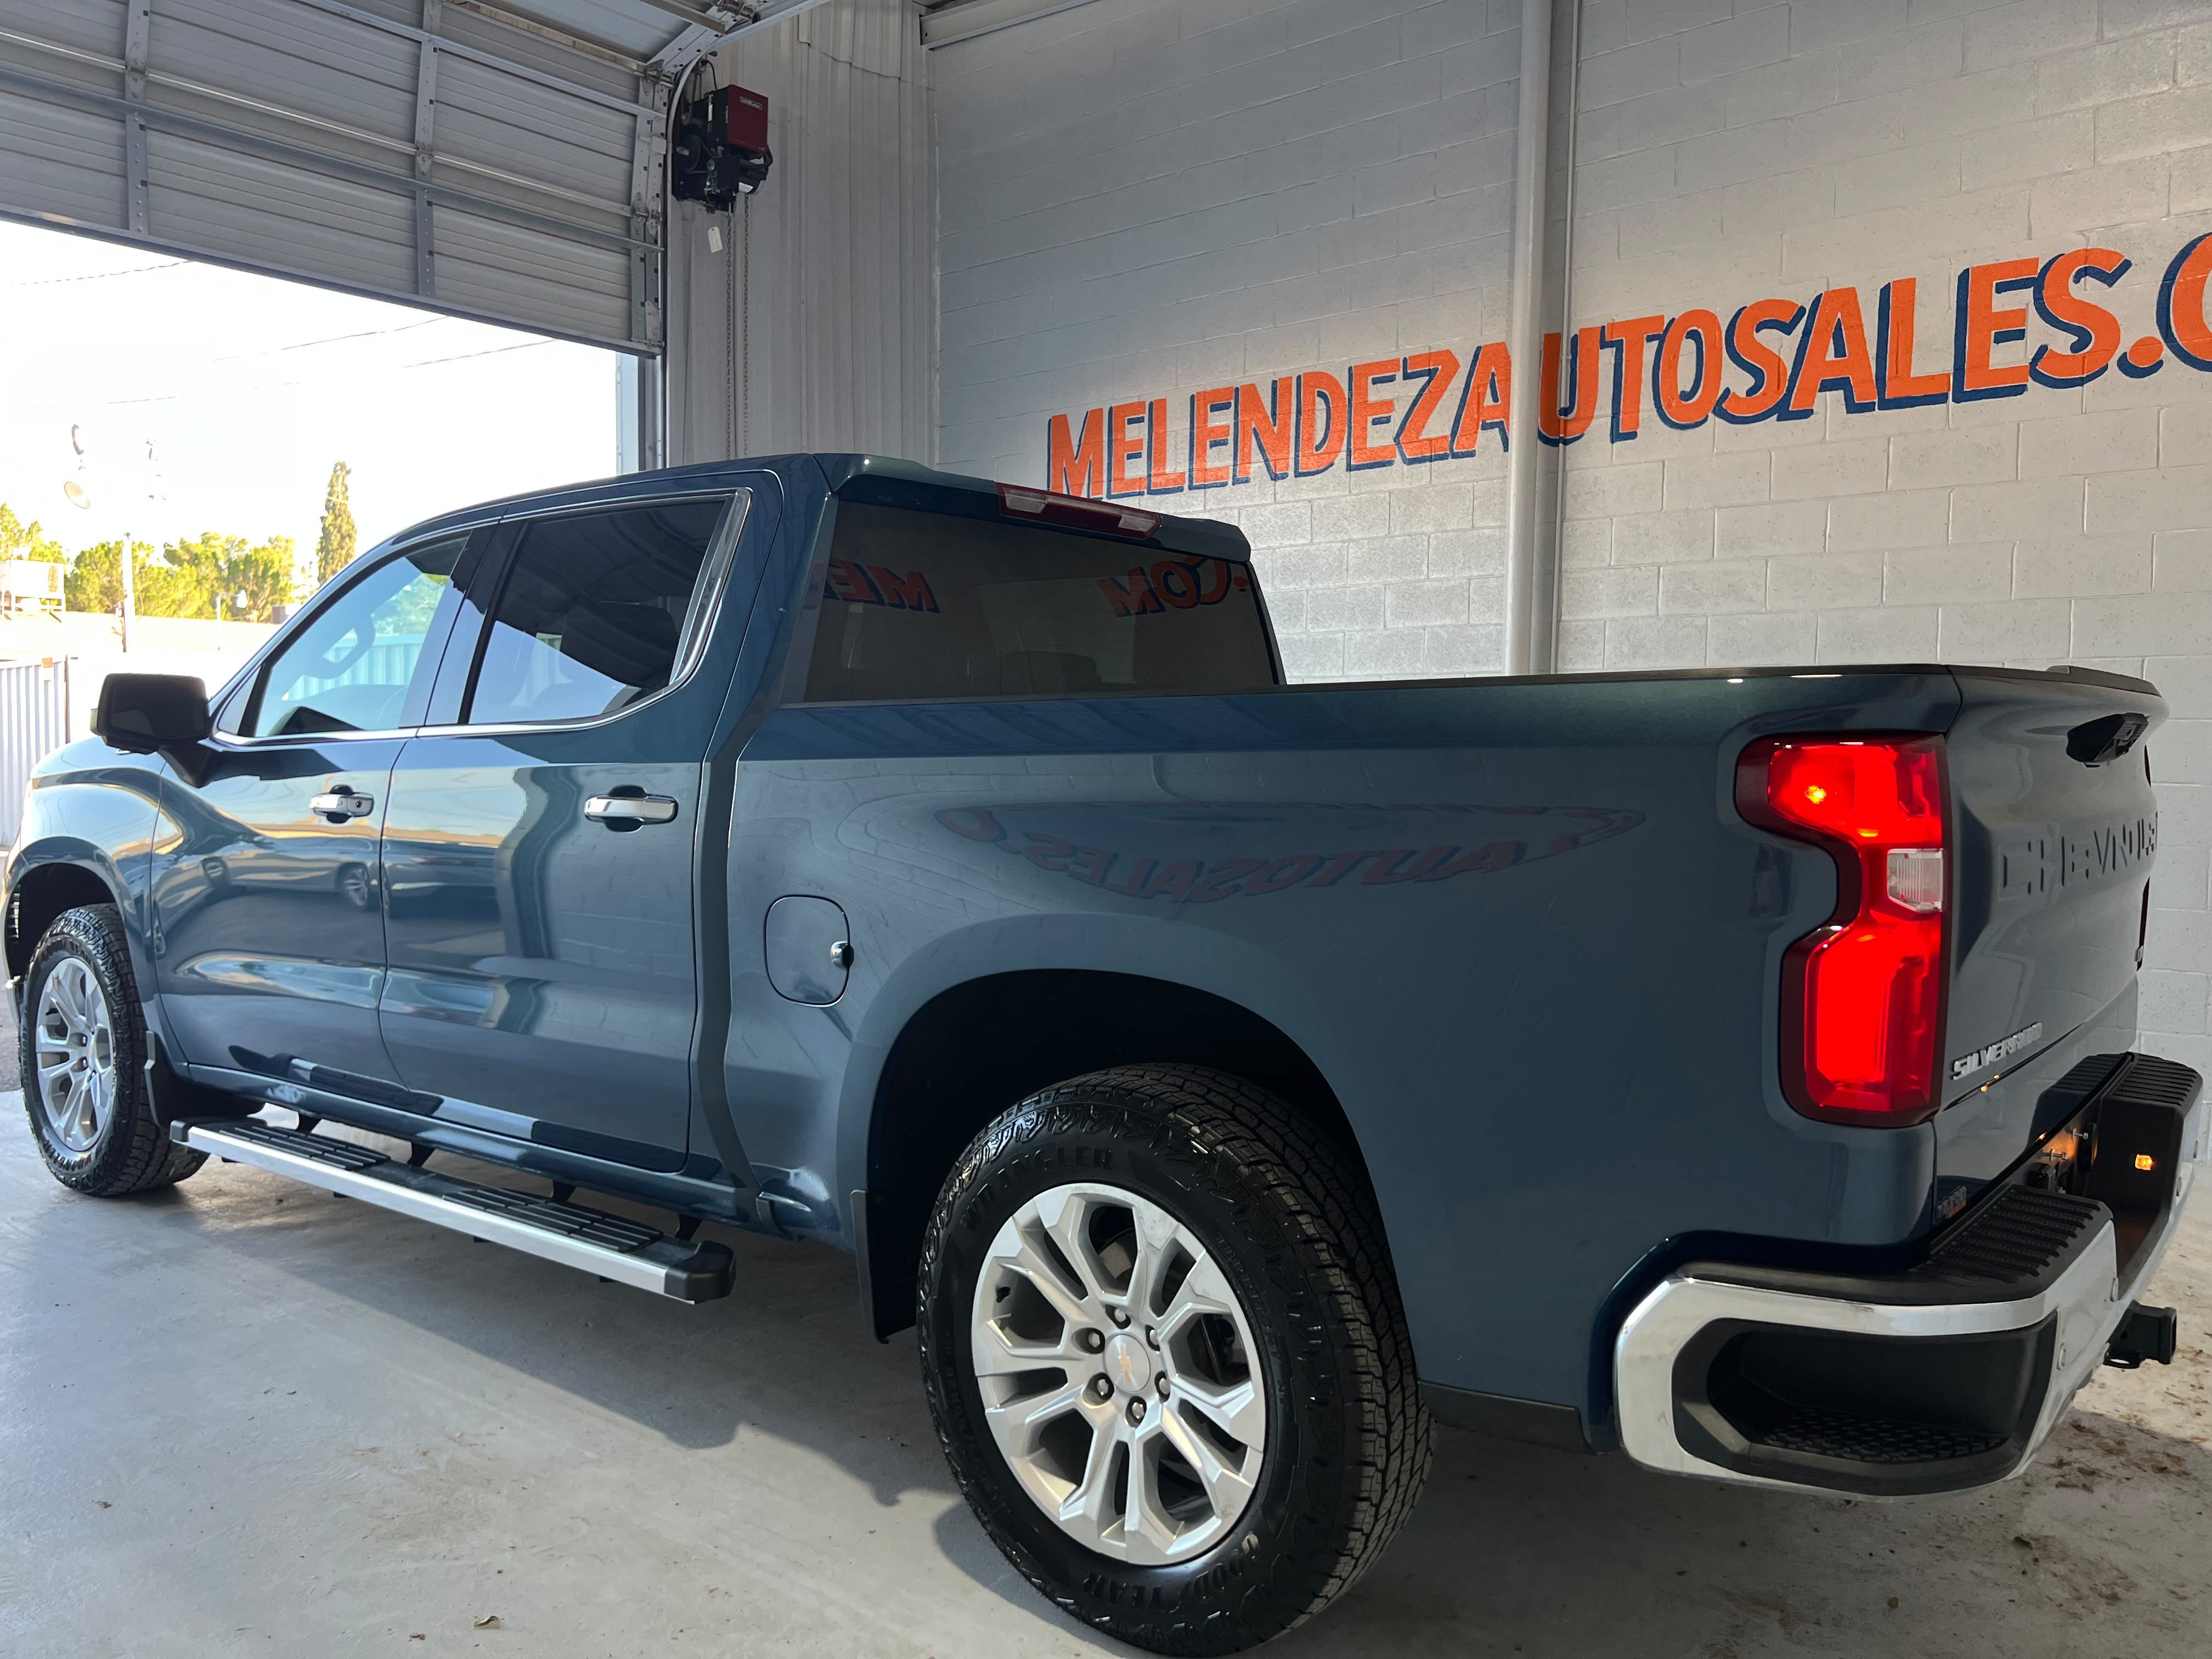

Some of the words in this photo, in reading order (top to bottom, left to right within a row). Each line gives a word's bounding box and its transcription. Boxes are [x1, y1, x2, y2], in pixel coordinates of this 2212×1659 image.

[1997, 811, 2158, 903] CHEVROLET
[1950, 1021, 2043, 1081] SILVERADO
[960, 1144, 1115, 1232] WRANGLER
[1081, 1530, 1261, 1614] GOODYEAR
